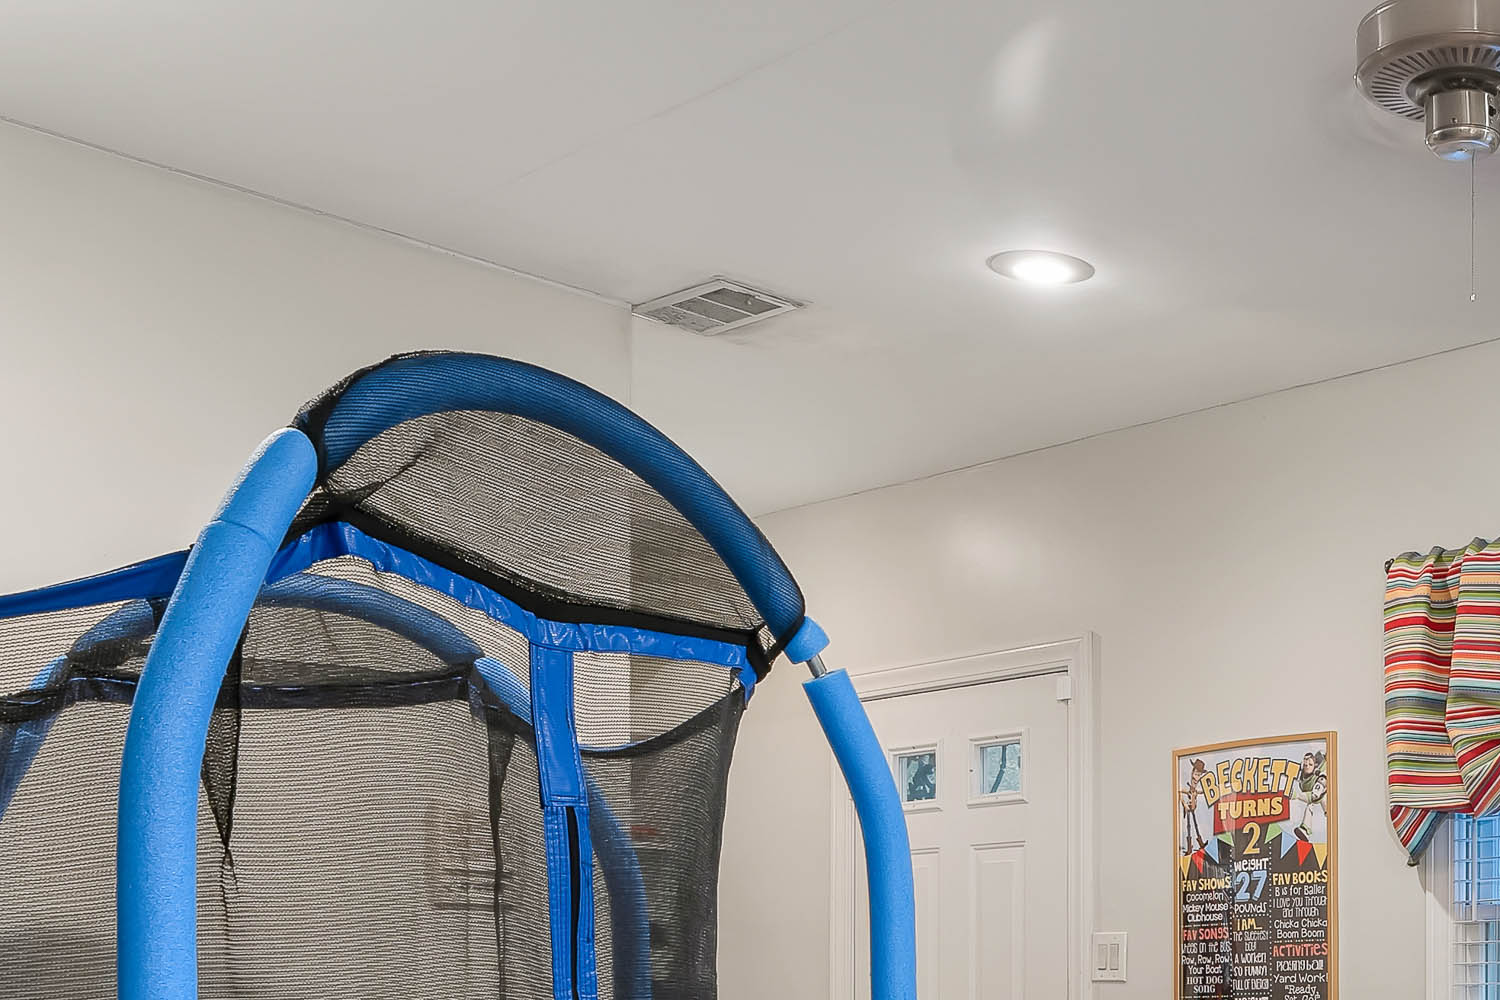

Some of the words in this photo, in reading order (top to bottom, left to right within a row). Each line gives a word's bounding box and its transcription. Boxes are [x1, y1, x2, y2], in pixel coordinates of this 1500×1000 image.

[1200, 757, 1301, 808] BECKETT
[1218, 797, 1283, 820] TURNS
[1243, 821, 1261, 855] 2
[1182, 879, 1197, 891] FAV
[1199, 876, 1231, 890] SHOWS
[1273, 873, 1290, 885] FAV
[1292, 870, 1328, 884] BOOKS
[1234, 870, 1268, 902] 27
[1275, 887, 1280, 896] B
[1282, 887, 1287, 895] is
[1290, 885, 1302, 896] for
[1303, 884, 1326, 895] Baller
[1182, 904, 1204, 915] Mickey
[1205, 902, 1229, 912] Mouse
[1274, 920, 1299, 929] Chicka
[1301, 918, 1328, 928] Chicka
[1183, 929, 1197, 940] FAV
[1276, 929, 1299, 939] Boom
[1301, 928, 1325, 938] Boom
[1188, 965, 1204, 975] Your
[1205, 964, 1222, 974] Boat
[1187, 976, 1204, 985] HOT
[1206, 976, 1223, 984] DOG
[1273, 973, 1297, 983] Yard
